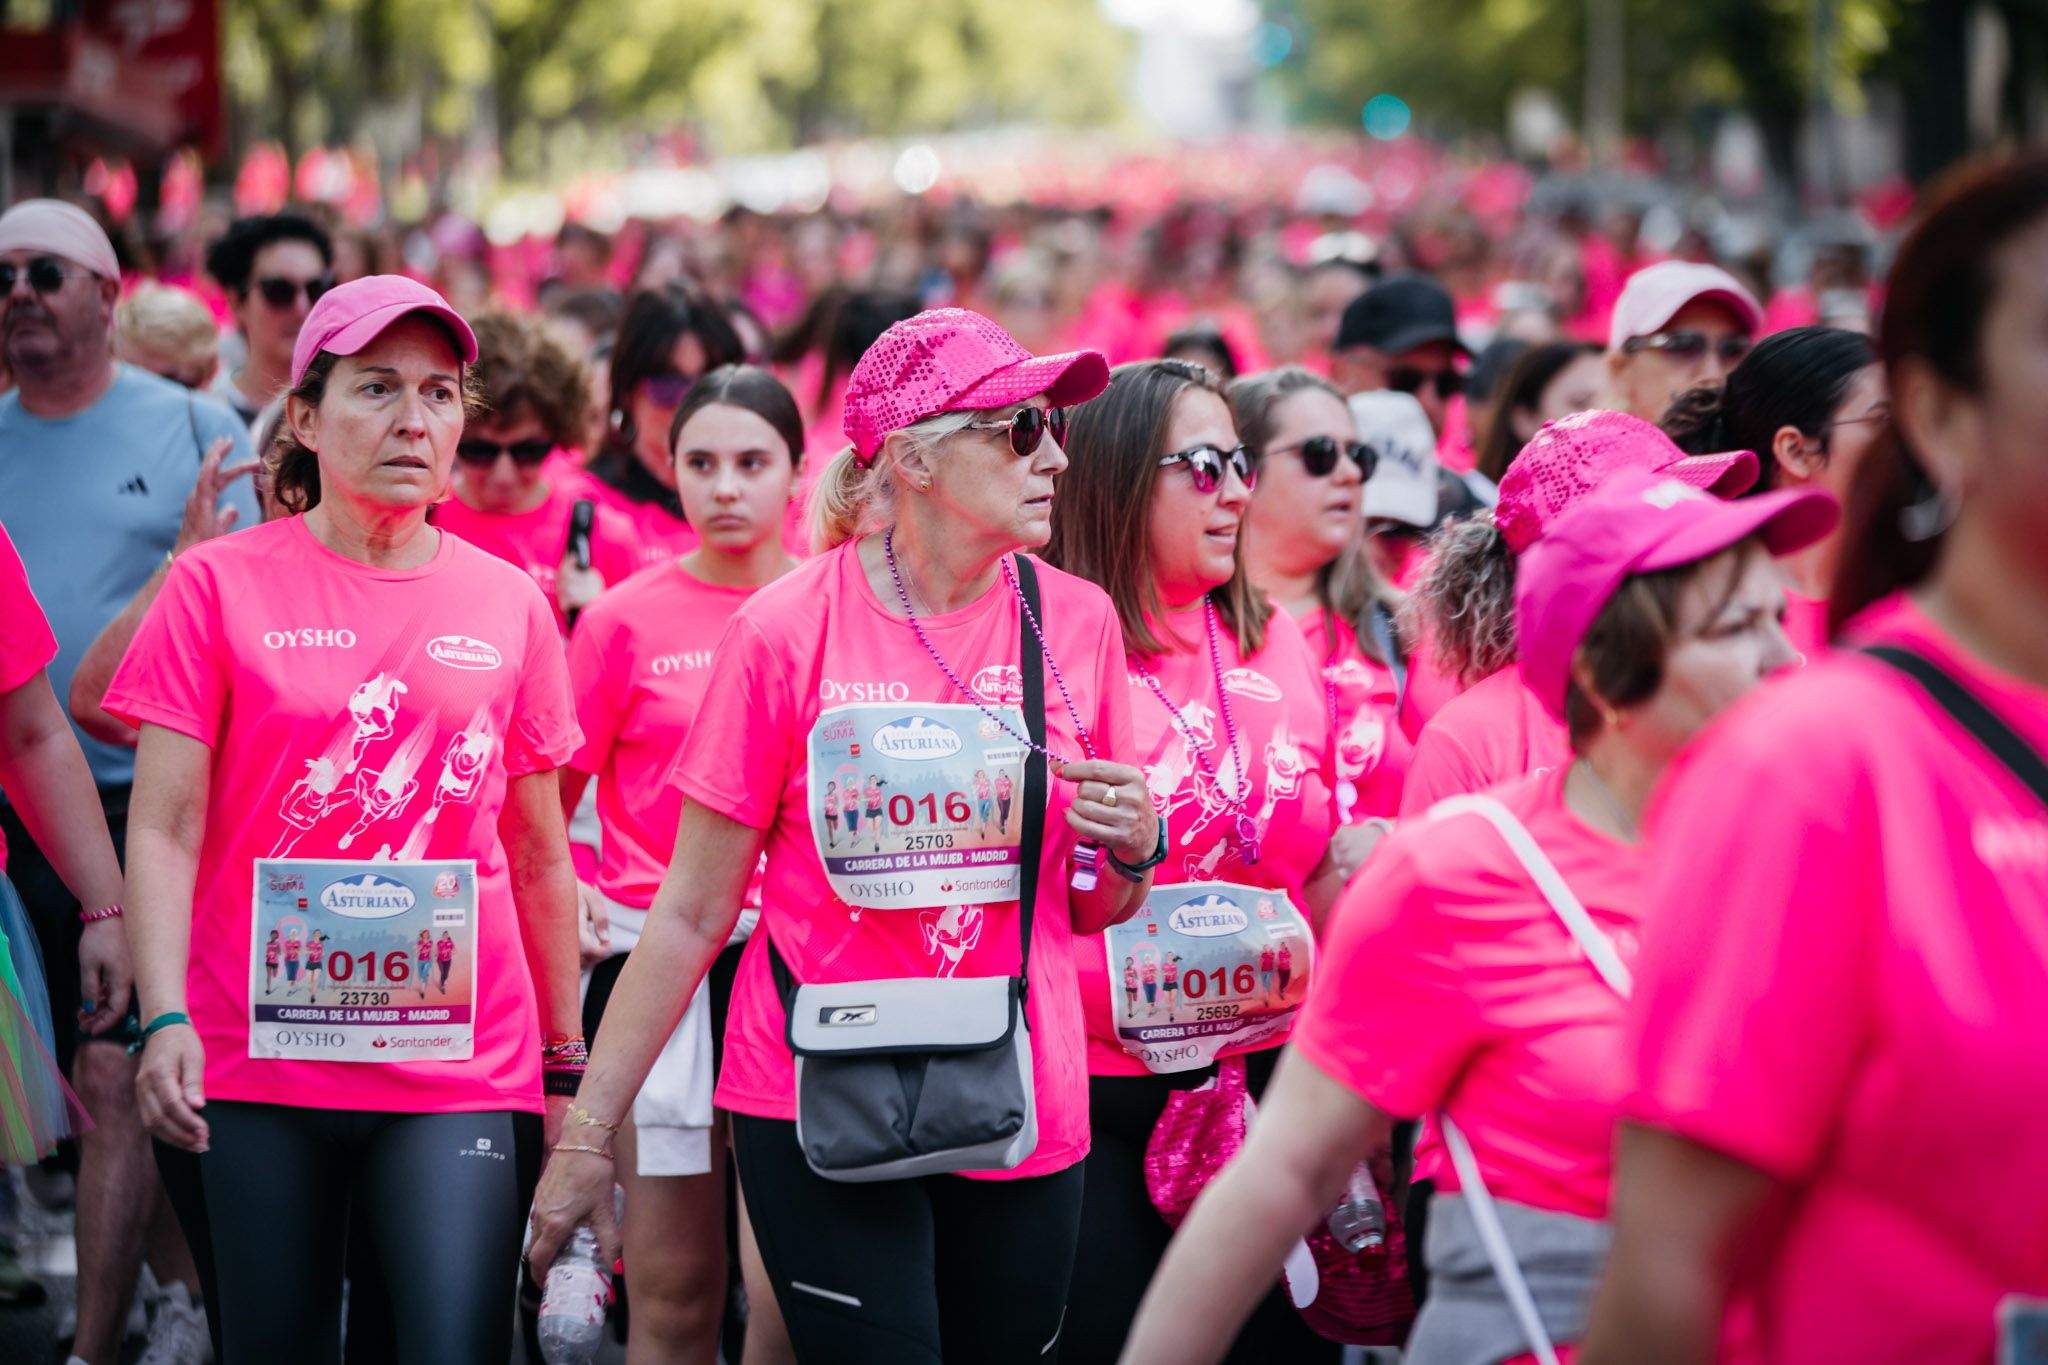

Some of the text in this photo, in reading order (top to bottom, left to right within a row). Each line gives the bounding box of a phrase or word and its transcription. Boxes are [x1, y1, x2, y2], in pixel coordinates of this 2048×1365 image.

[263, 628, 357, 650] OYSHO
[651, 650, 712, 676] OYSH
[820, 679, 910, 701] OYSHO
[880, 733, 957, 751] ASTURIANA
[888, 791, 972, 827] 016
[905, 834, 954, 851] 25703
[844, 858, 894, 873] CARRERA
[896, 857, 911, 869] DE
[913, 855, 928, 868] LA
[930, 853, 964, 866] MUJER
[971, 851, 1009, 864] MADRID
[850, 881, 914, 898] OYSHO
[955, 878, 1012, 893] Santander
[326, 889, 410, 908] ASTURIANA
[327, 950, 410, 982] 016
[1182, 963, 1255, 999] 016
[339, 991, 390, 1006] 23730
[276, 1008, 327, 1020] CARRERA
[329, 1009, 345, 1021] DE
[346, 1009, 360, 1021] LA
[362, 1009, 400, 1022] MUJER
[408, 1009, 450, 1021] MADRID
[1196, 1004, 1241, 1021] 25692
[276, 1031, 346, 1048] OYSHO
[1139, 1027, 1186, 1041] CARRERA
[1188, 1026, 1201, 1036] DE
[1202, 1024, 1214, 1034] LA
[390, 1035, 453, 1049] Santander
[1141, 1044, 1199, 1064] OYSHO
